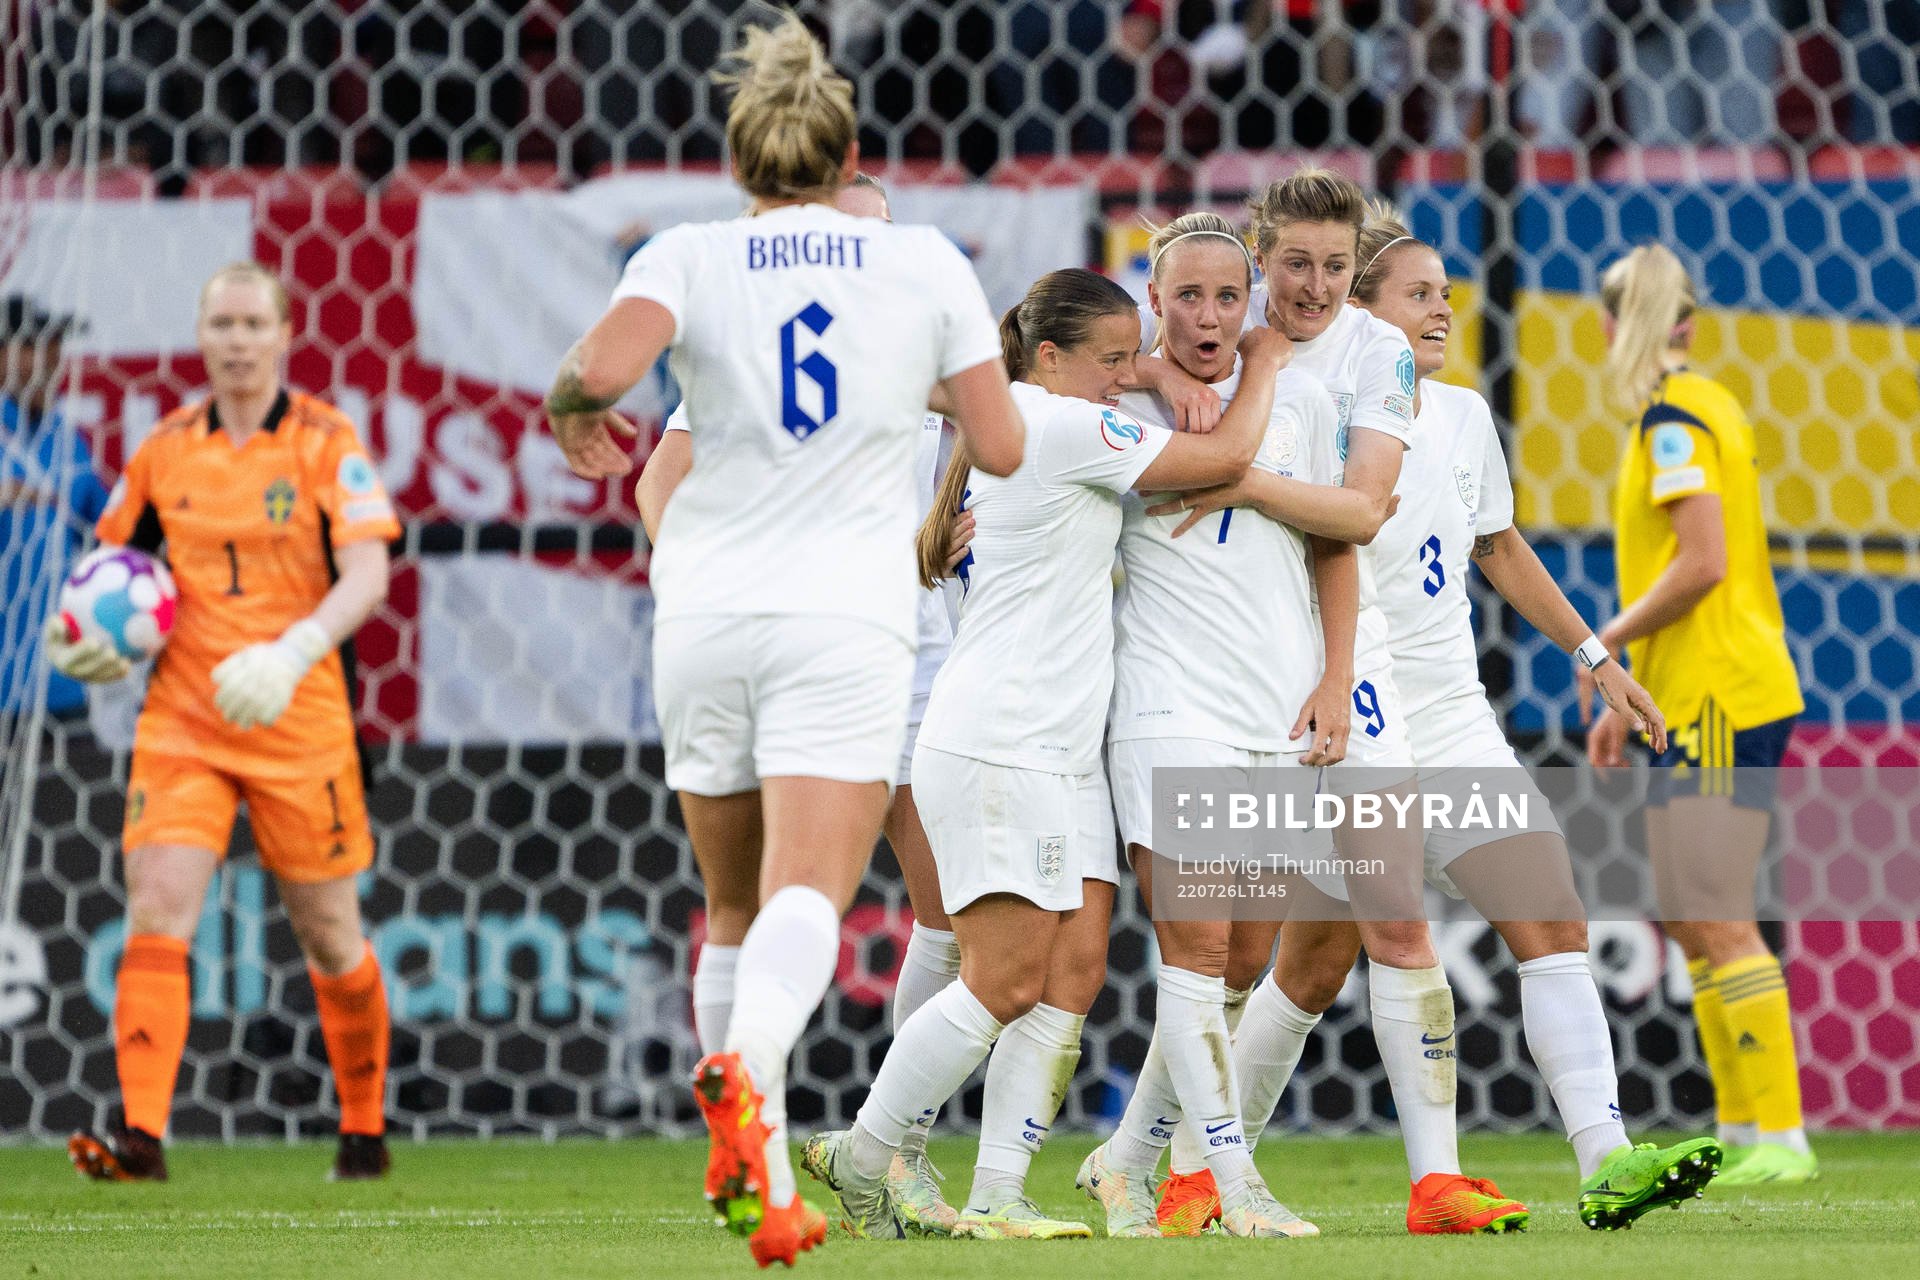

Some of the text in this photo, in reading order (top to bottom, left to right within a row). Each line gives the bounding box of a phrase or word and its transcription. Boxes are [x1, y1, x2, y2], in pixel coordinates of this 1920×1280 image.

[748, 230, 868, 270] BRIGHT
[780, 301, 838, 442] 6
[223, 540, 245, 596] 1
[1419, 534, 1446, 598] 3
[1352, 679, 1386, 738] 9
[325, 779, 346, 833] 1
[1423, 1049, 1456, 1060] En
[1150, 1126, 1175, 1140] En
[1210, 1134, 1242, 1147] Eng
